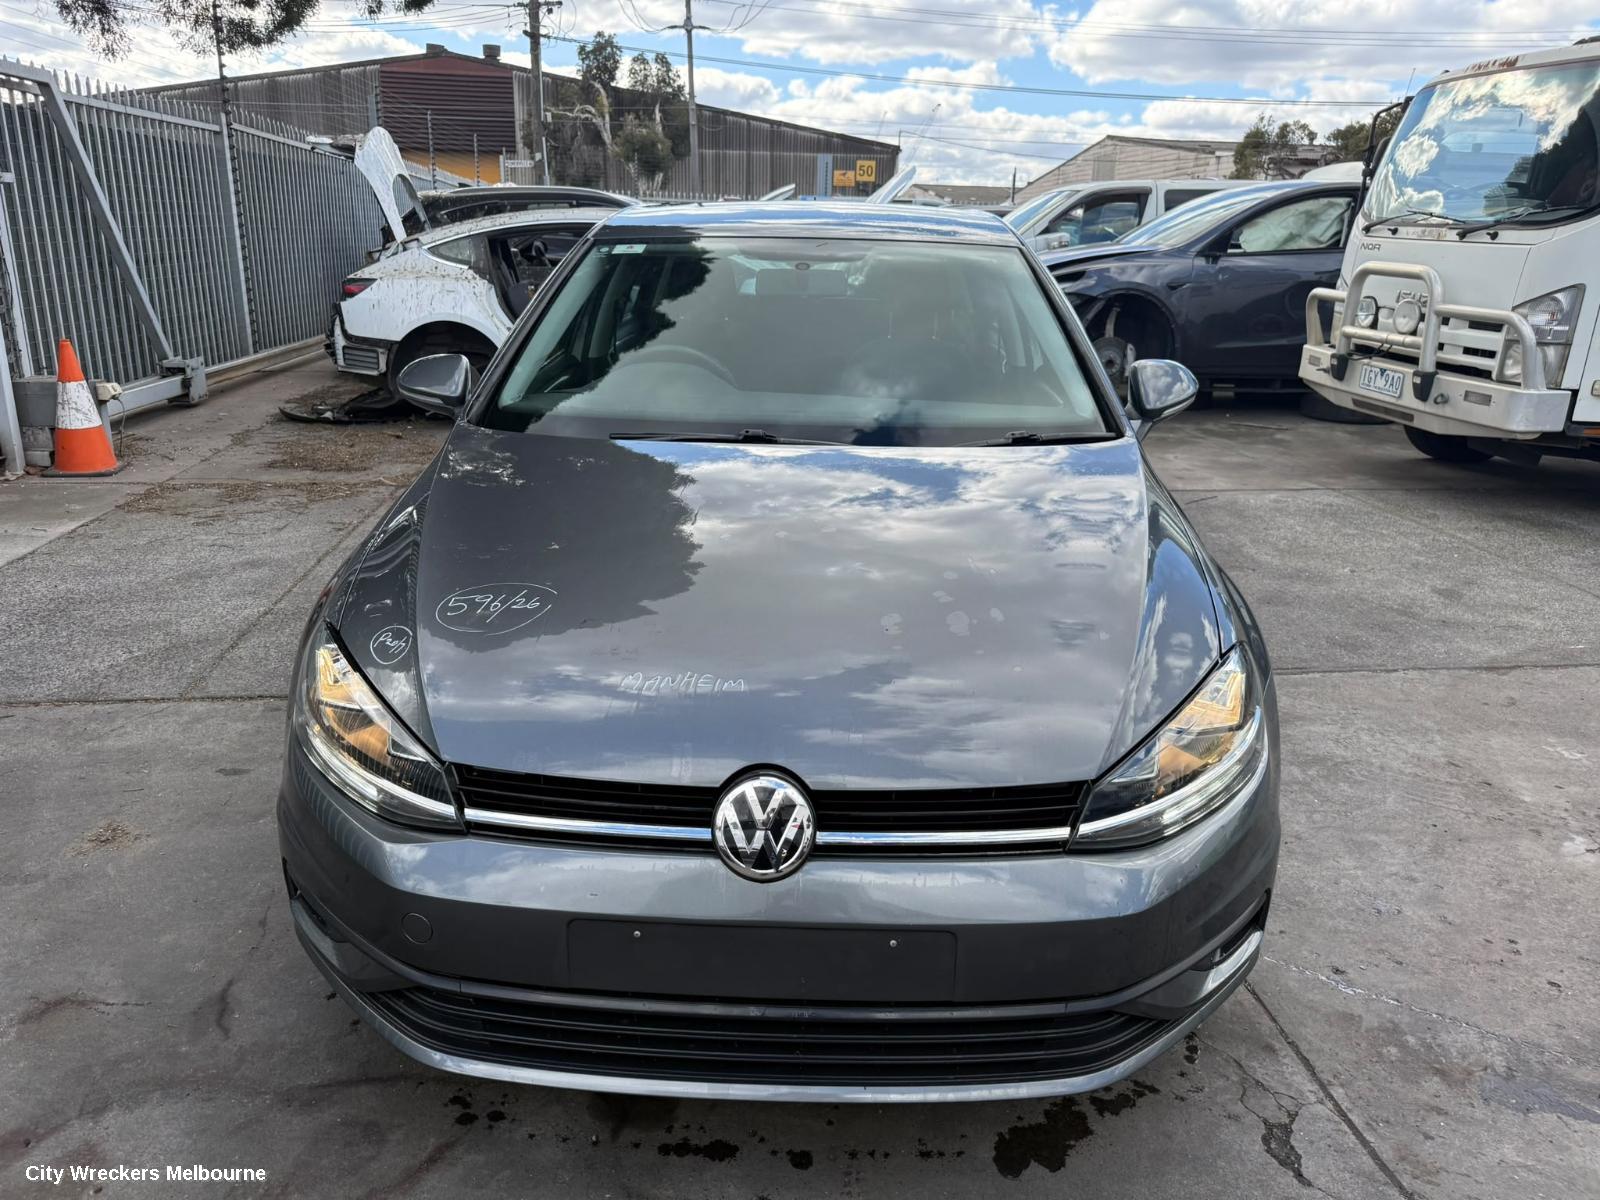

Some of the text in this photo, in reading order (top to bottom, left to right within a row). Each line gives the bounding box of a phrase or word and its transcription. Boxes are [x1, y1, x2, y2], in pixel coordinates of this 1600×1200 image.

[859, 165, 873, 177] 50
[1360, 242, 1381, 251] NQR
[447, 589, 540, 623] 596/26
[619, 671, 745, 694] MANHEIM
[717, 779, 810, 874] VW
